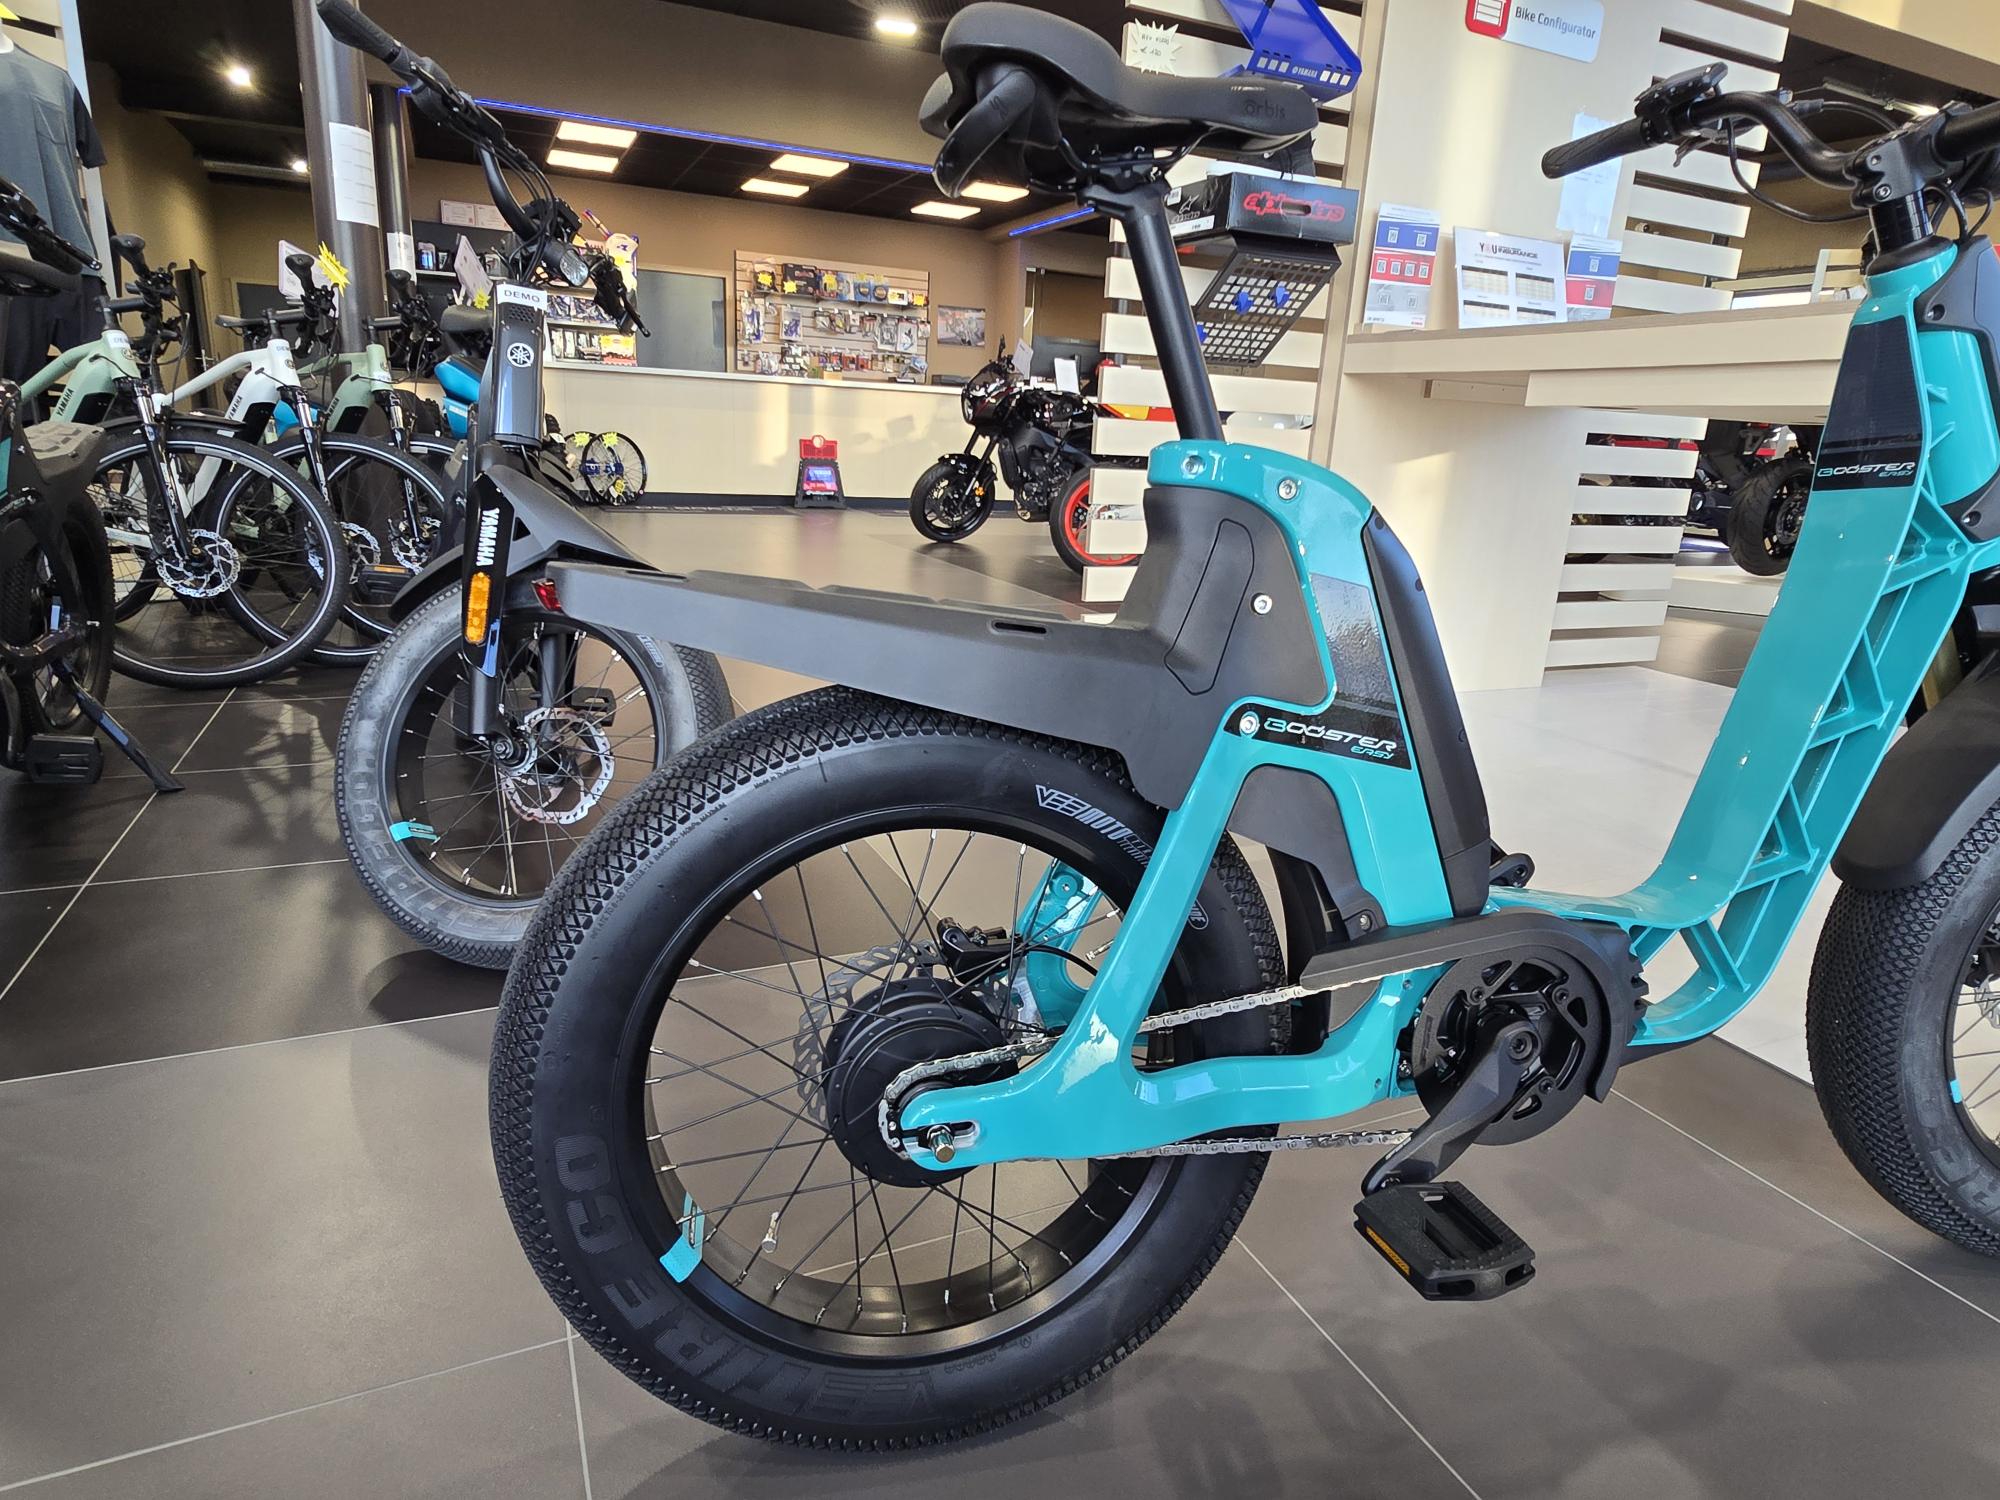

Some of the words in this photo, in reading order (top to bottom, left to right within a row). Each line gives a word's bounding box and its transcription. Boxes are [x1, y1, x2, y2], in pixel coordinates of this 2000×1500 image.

[1515, 6, 1535, 22] Bike
[1538, 13, 1596, 39] Configurator
[504, 289, 540, 303] DEMO
[56, 388, 74, 416] YAMAHA
[1817, 461, 1916, 477] BOOSTER
[475, 507, 500, 567] YAMAHA
[1264, 717, 1397, 752] BOOSTER
